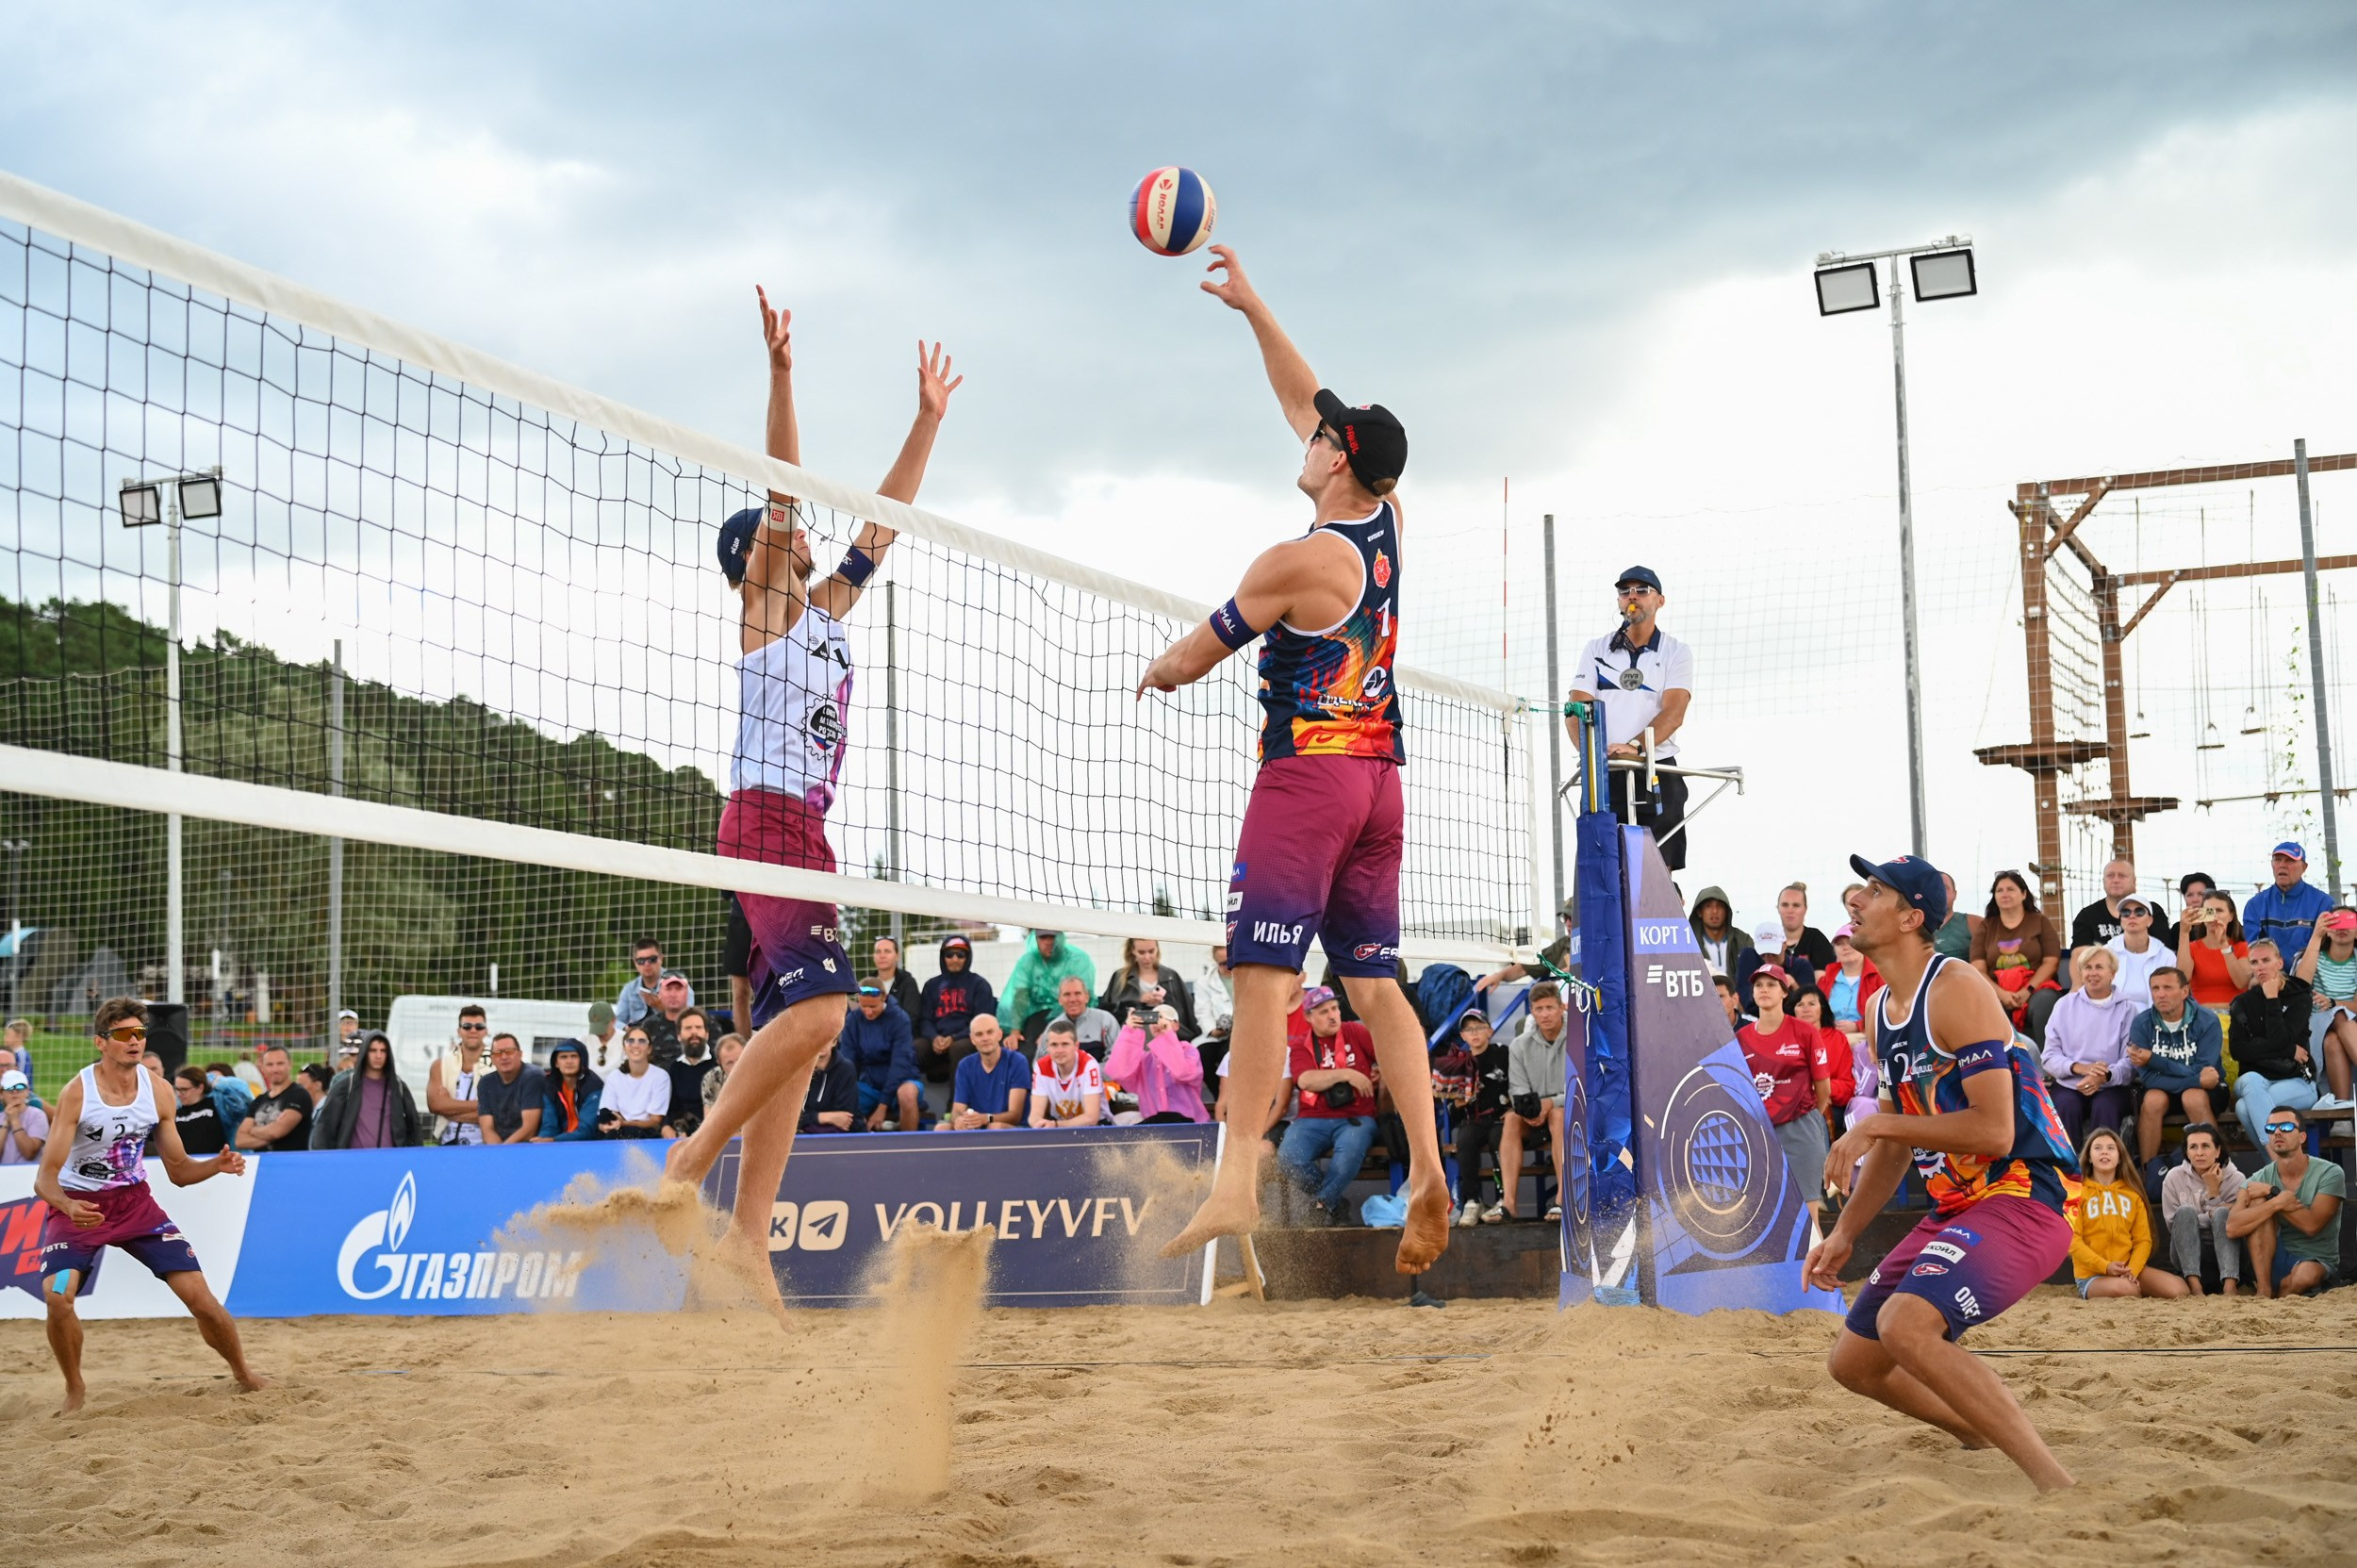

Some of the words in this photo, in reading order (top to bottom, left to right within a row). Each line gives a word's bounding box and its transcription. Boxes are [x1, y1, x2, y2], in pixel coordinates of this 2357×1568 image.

[1376, 597, 1391, 637] 1
[1253, 920, 1303, 946] ИЛЬЯ
[1640, 925, 1678, 946] КОРТ
[1684, 928, 1691, 944] 1
[1665, 969, 1704, 998] ВТБ
[1894, 1052, 1912, 1082] 2
[112, 1123, 125, 1142] 2
[2086, 1190, 2132, 1220] GAP
[400, 1251, 585, 1300] ГАЗПРОМ
